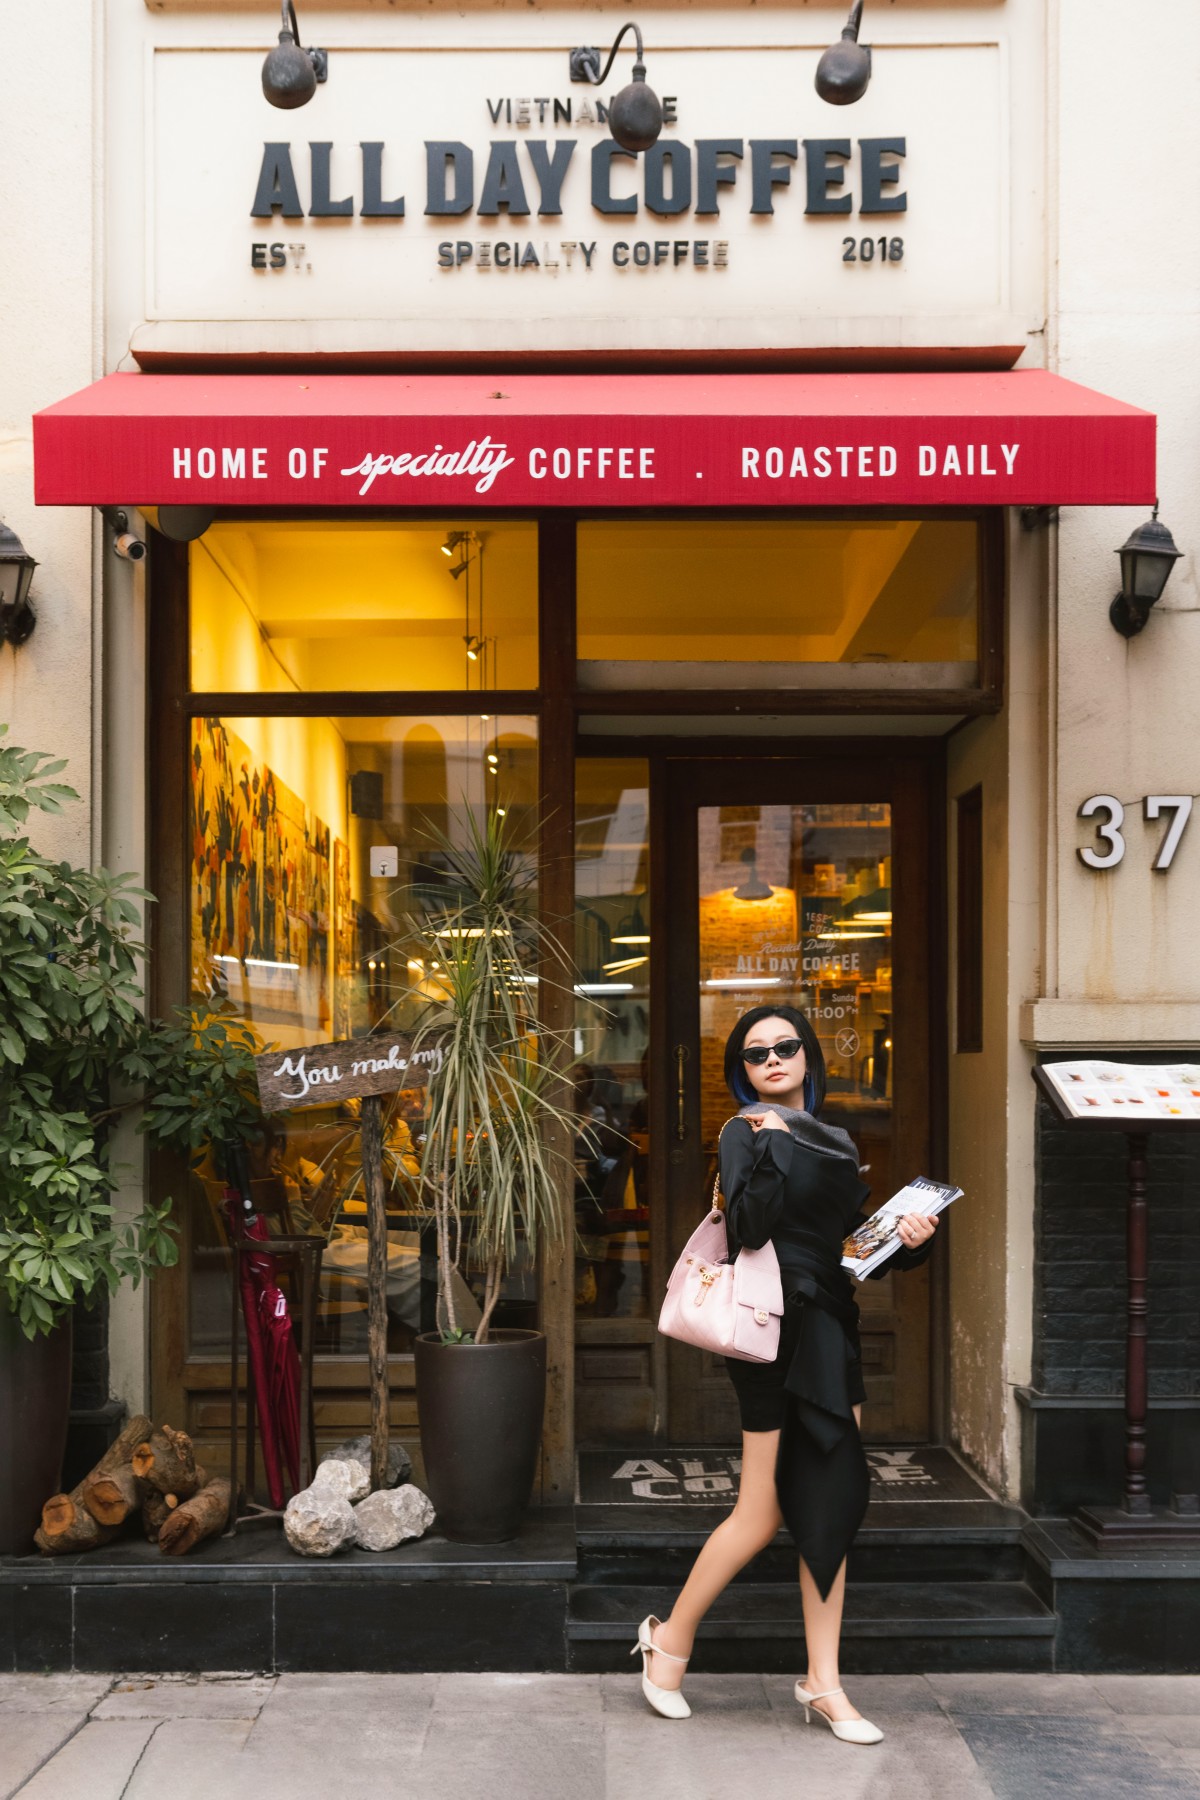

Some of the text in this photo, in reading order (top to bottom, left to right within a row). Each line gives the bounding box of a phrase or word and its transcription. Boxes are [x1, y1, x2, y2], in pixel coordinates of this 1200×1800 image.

[250, 137, 908, 220] ALL DAY COFFEE
[437, 240, 730, 271] SPECIALTY COFFEE
[842, 236, 905, 263] 2018
[172, 447, 269, 479] HOME
[288, 447, 329, 479] OF
[340, 435, 516, 496] specialty
[529, 447, 656, 479] COFFEE
[741, 445, 897, 478] ROASTED
[918, 444, 1021, 476] DAILY
[1076, 793, 1193, 870] 37
[736, 953, 861, 973] ALL DAY COFFEE
[734, 993, 763, 1004] Monday
[831, 993, 859, 1004] Sunday
[273, 1054, 344, 1100] You
[351, 1045, 408, 1077] make
